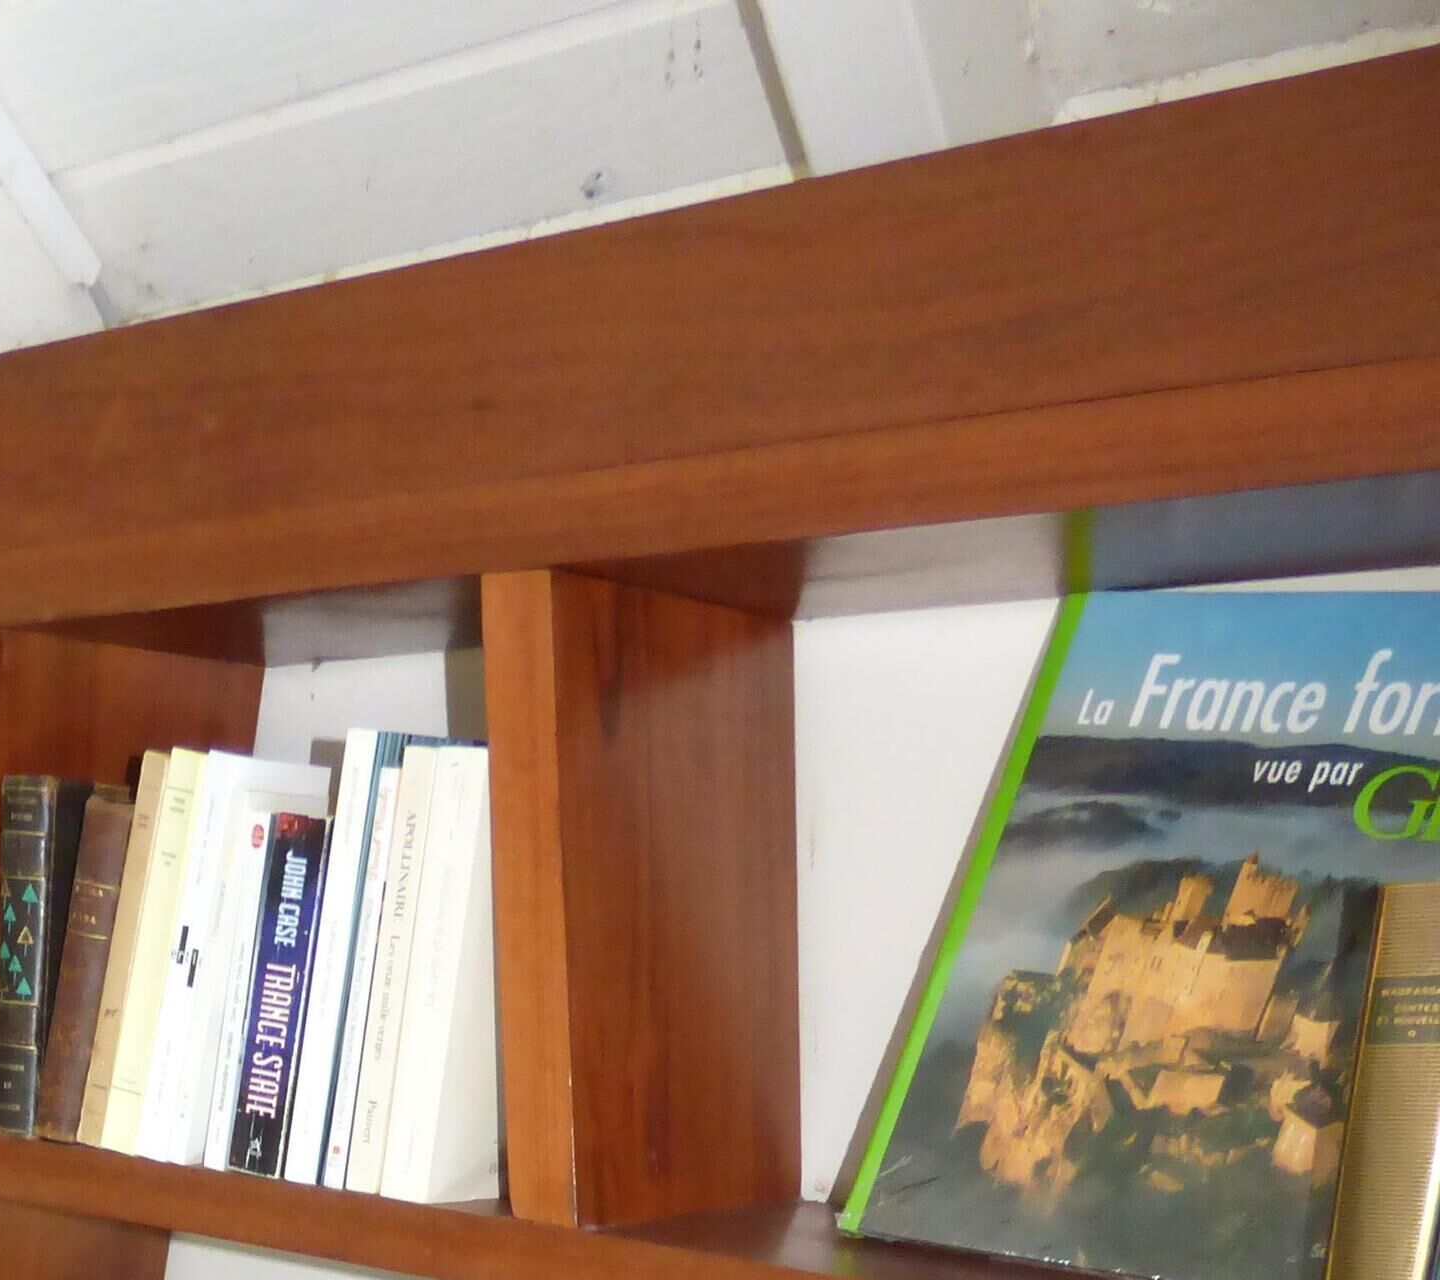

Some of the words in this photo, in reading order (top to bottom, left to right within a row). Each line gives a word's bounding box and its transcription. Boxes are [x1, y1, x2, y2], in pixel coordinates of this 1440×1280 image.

[1078, 689, 1115, 726] La
[1129, 653, 1326, 734] France
[1343, 648, 1440, 737] for
[1251, 758, 1302, 784] vue
[1308, 758, 1364, 793] par
[282, 851, 307, 900] JOHN
[393, 811, 417, 920] APOLLINAIRE
[275, 903, 301, 948] CASE
[255, 963, 296, 1050] TRANCE
[245, 1051, 283, 1119] STATE
